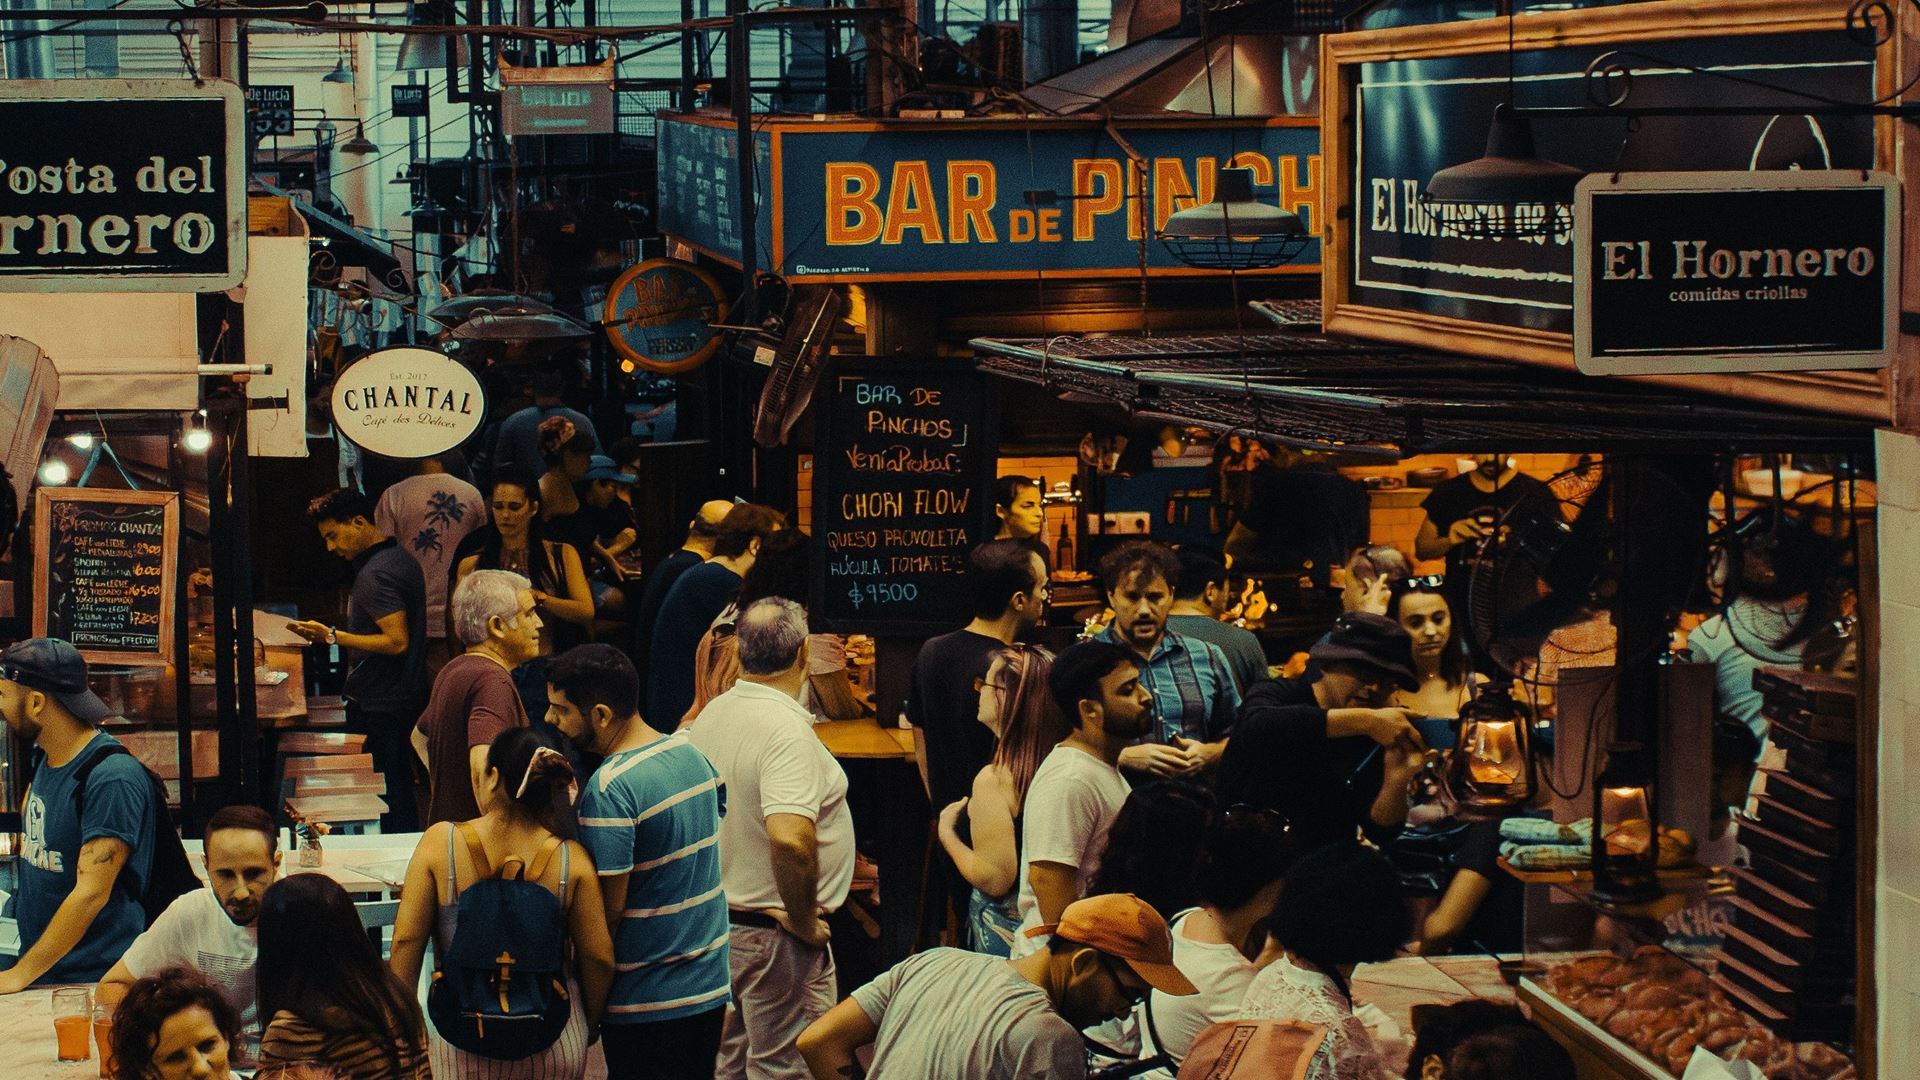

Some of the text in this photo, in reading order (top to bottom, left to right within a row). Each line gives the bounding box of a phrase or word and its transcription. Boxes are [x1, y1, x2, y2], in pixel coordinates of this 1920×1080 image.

[0, 155, 215, 194] osta del
[826, 160, 998, 246] BAR
[1009, 208, 1062, 243] DE
[1371, 177, 1397, 232] El
[0, 212, 215, 255] rnero
[1601, 240, 1875, 280] El Hornero
[1669, 286, 1808, 302] comidas criollas
[343, 385, 473, 416] CHANTAL
[857, 383, 942, 406] BAR DE
[361, 412, 456, 429] Café des Délices
[842, 488, 970, 520] CHORI FLOW
[827, 528, 967, 552] QUESO PROVOLETA
[848, 581, 918, 610] $9500
